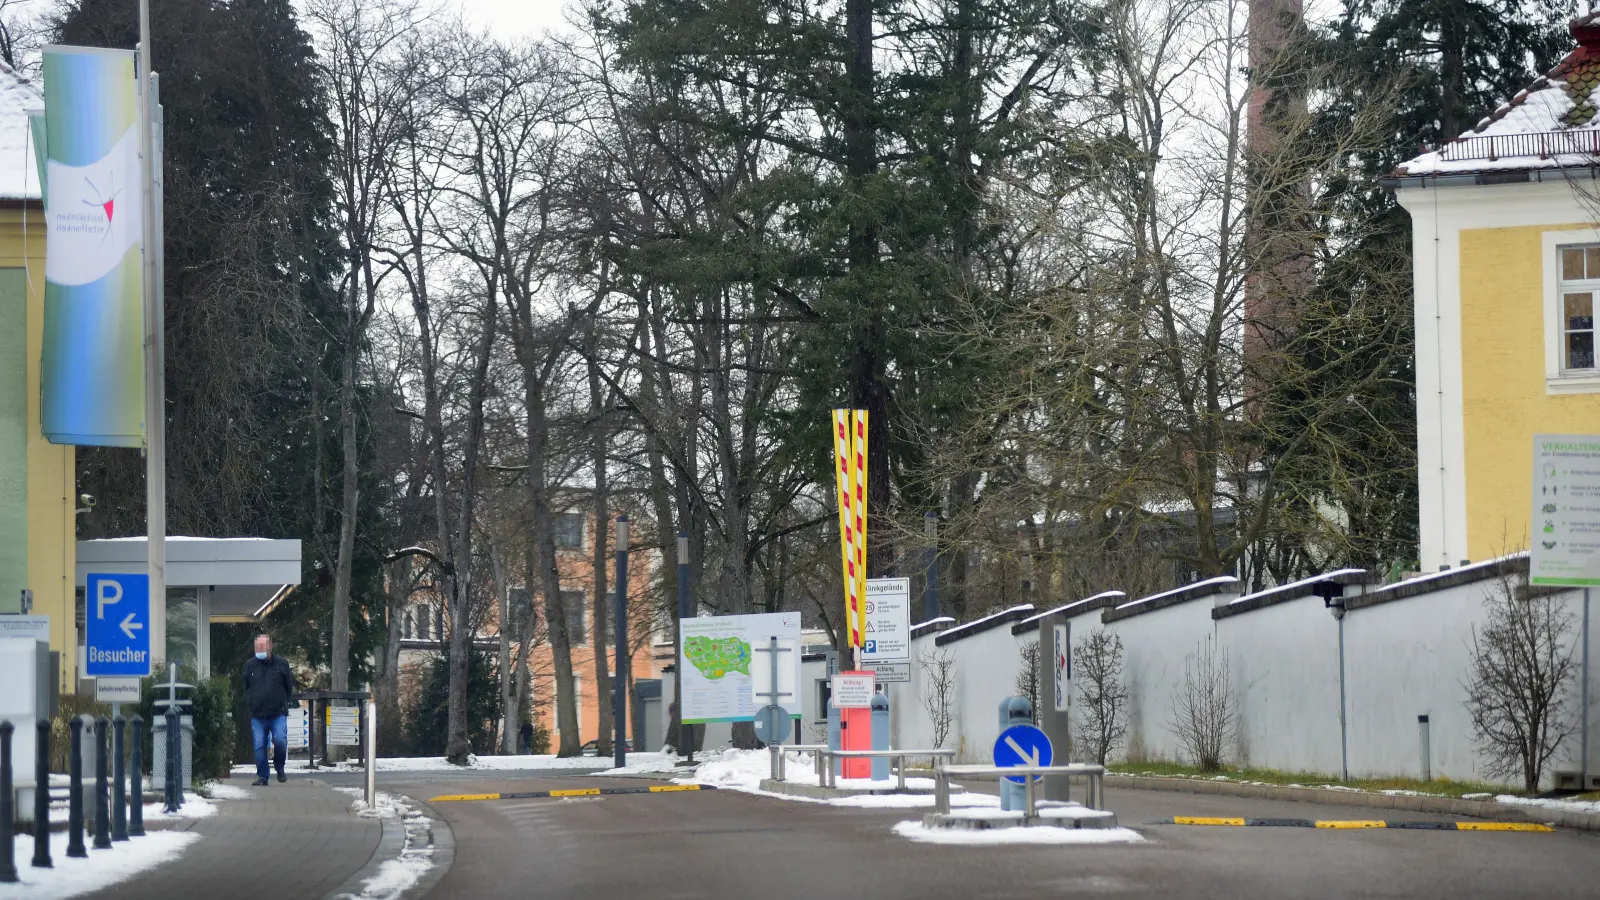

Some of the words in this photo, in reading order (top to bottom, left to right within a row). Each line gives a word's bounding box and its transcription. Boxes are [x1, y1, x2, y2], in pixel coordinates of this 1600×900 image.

[866, 584, 903, 592] linikgelände
[97, 579, 124, 620] P
[866, 641, 874, 652] P
[89, 646, 147, 663] Besucher
